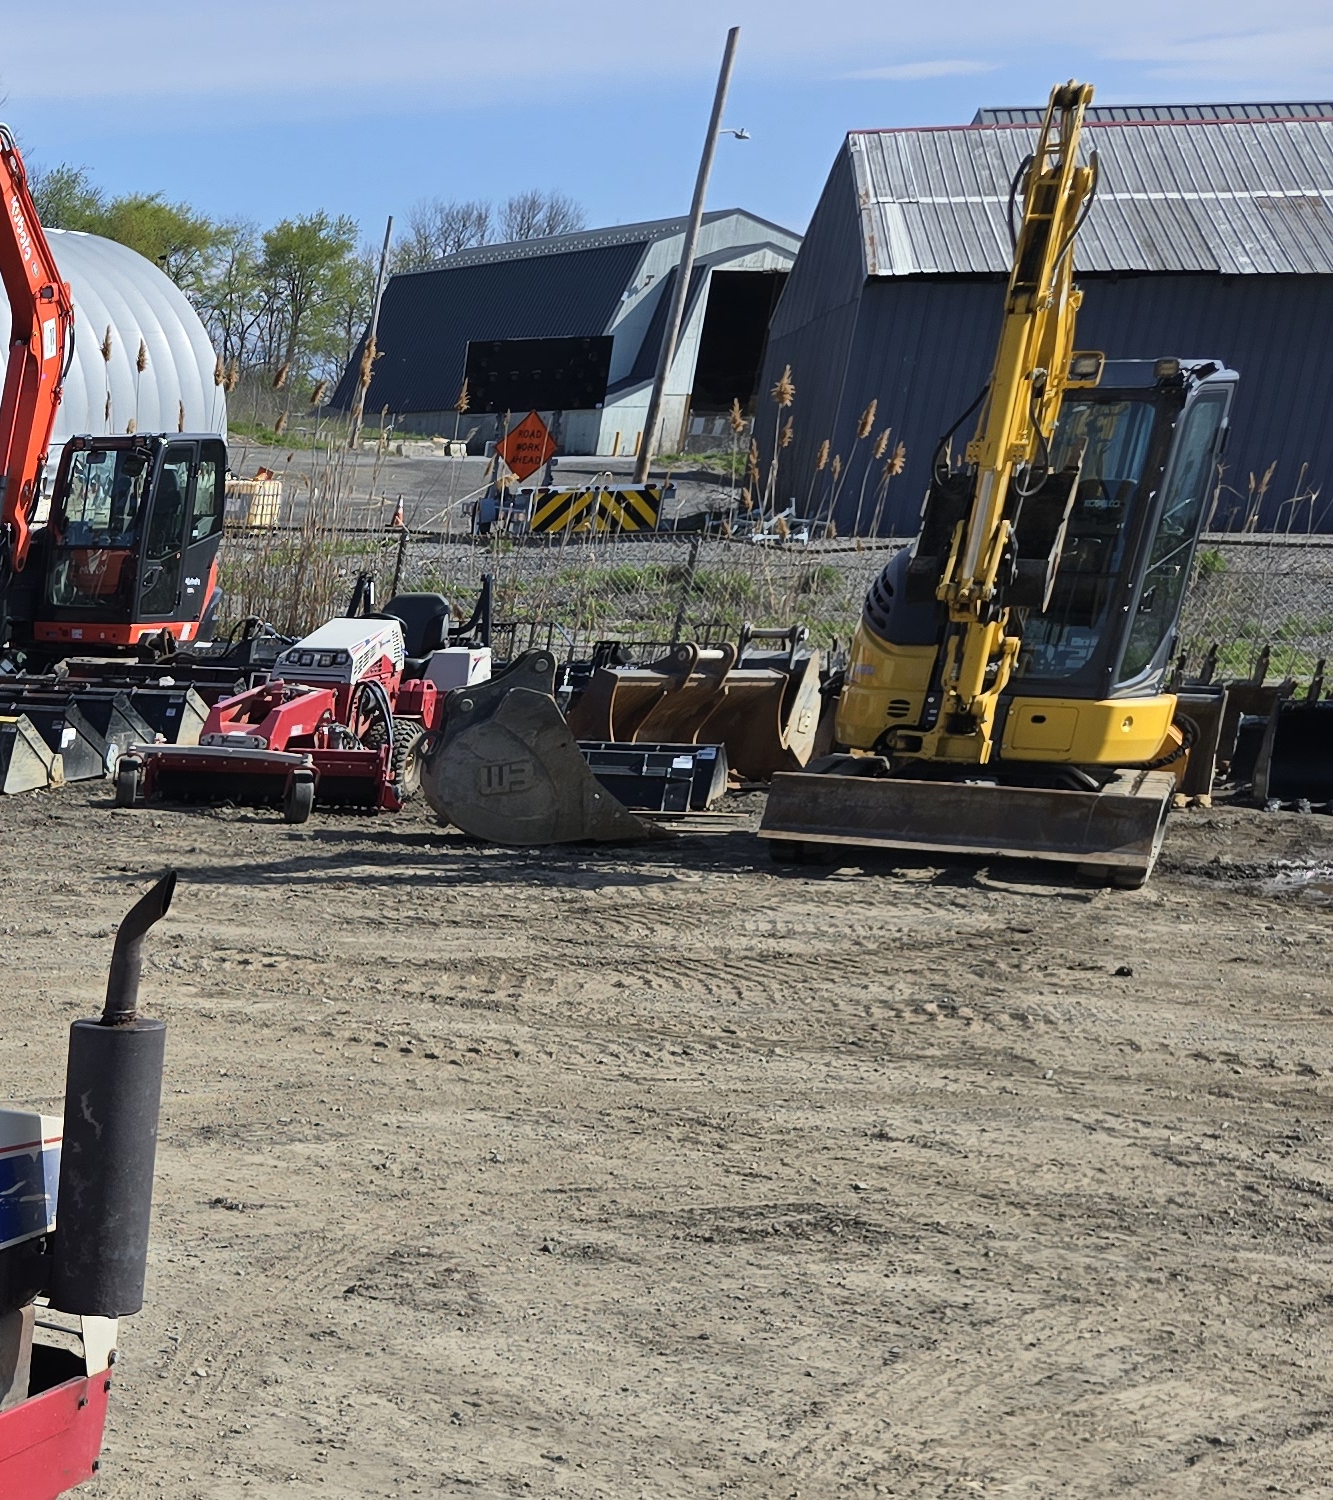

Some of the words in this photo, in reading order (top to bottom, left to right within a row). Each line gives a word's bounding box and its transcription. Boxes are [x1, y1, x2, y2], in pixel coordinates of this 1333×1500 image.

[11, 195, 32, 262] Kubota
[517, 429, 542, 439] ROAD
[516, 442, 540, 451] WORK
[510, 455, 542, 465] AHEAD
